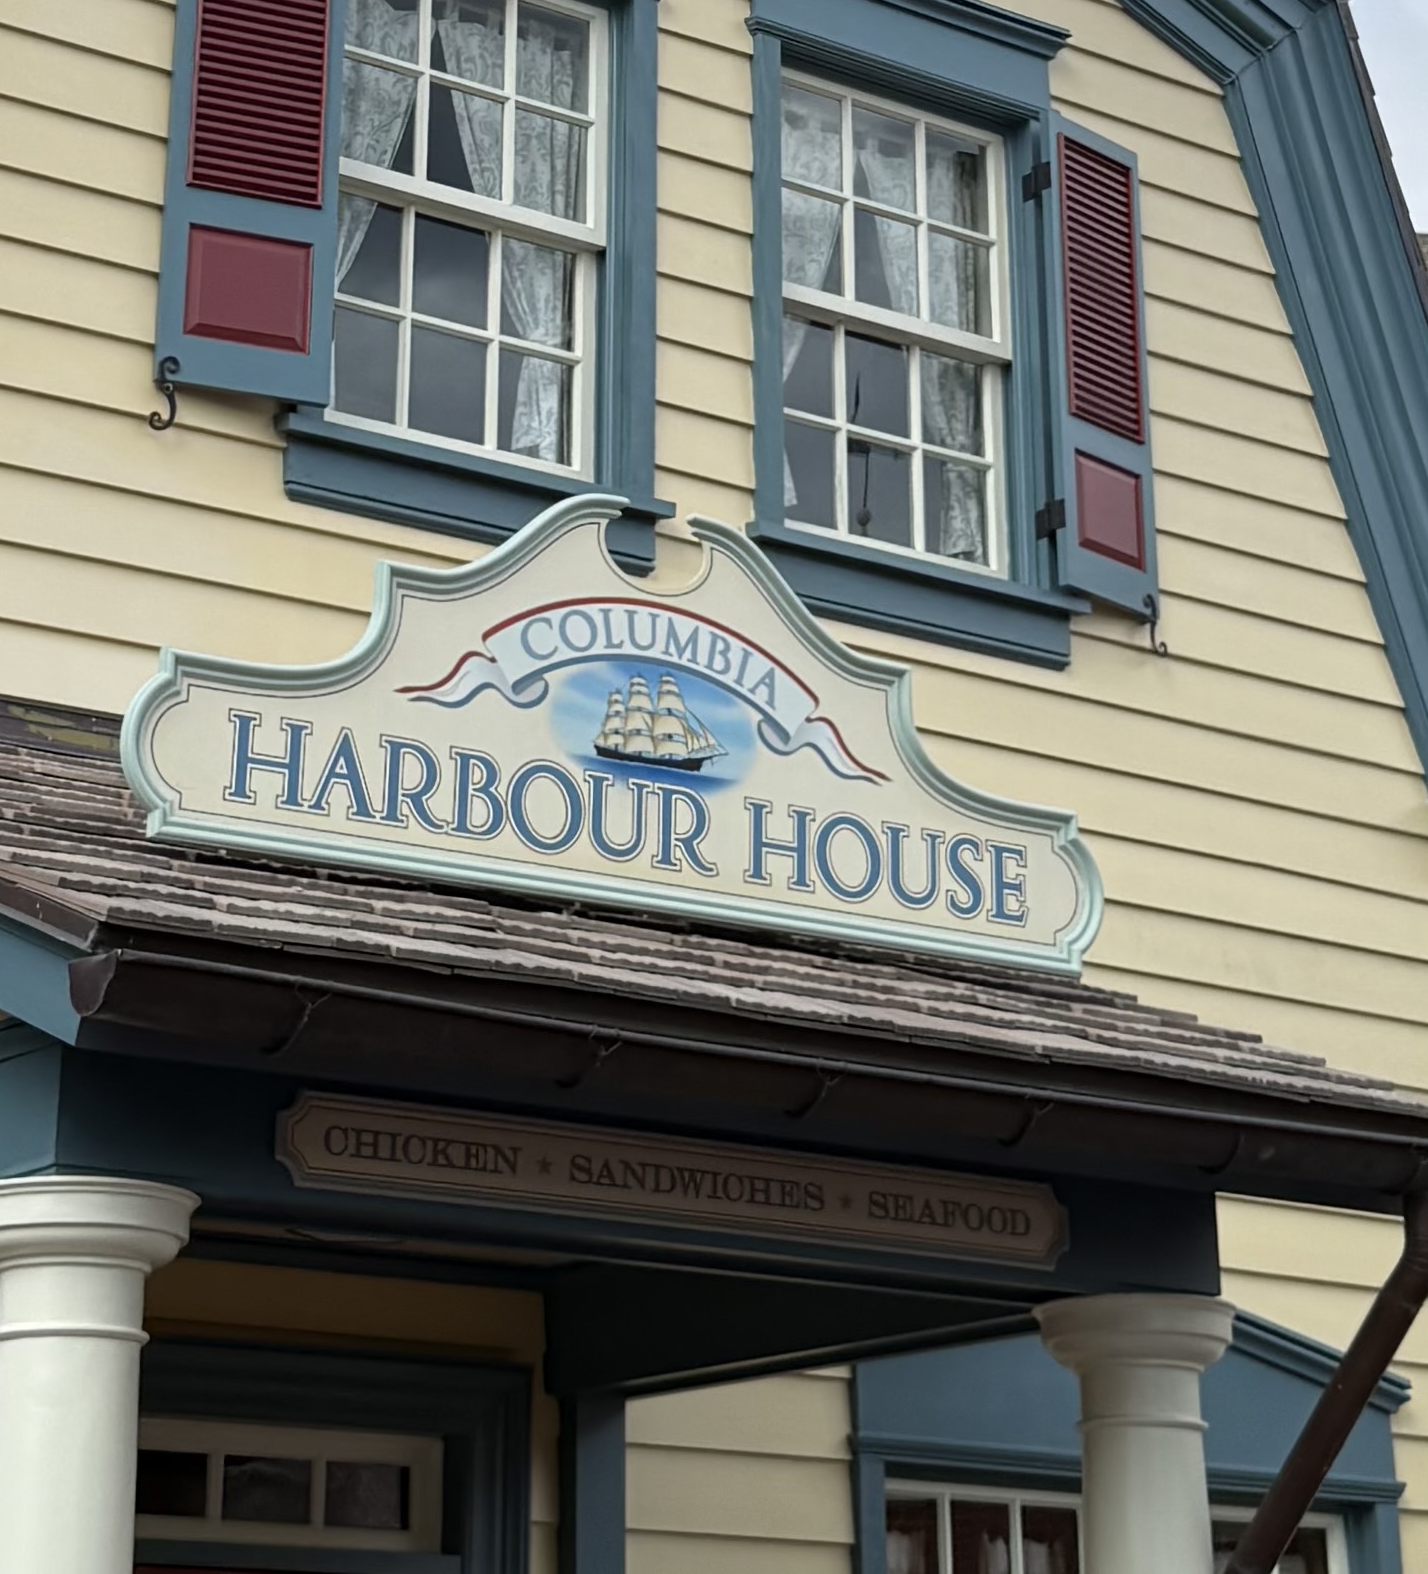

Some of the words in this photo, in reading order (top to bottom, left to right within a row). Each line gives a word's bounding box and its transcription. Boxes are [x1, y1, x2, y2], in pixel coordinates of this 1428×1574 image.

[520, 606, 779, 711] COLUMBIA
[224, 709, 718, 877] HARBOUR
[745, 796, 1029, 927] HOUSE
[324, 1125, 522, 1174] CHICKEN
[570, 1154, 825, 1211] SANDWICHES
[868, 1191, 1031, 1236] SEAFOOD
